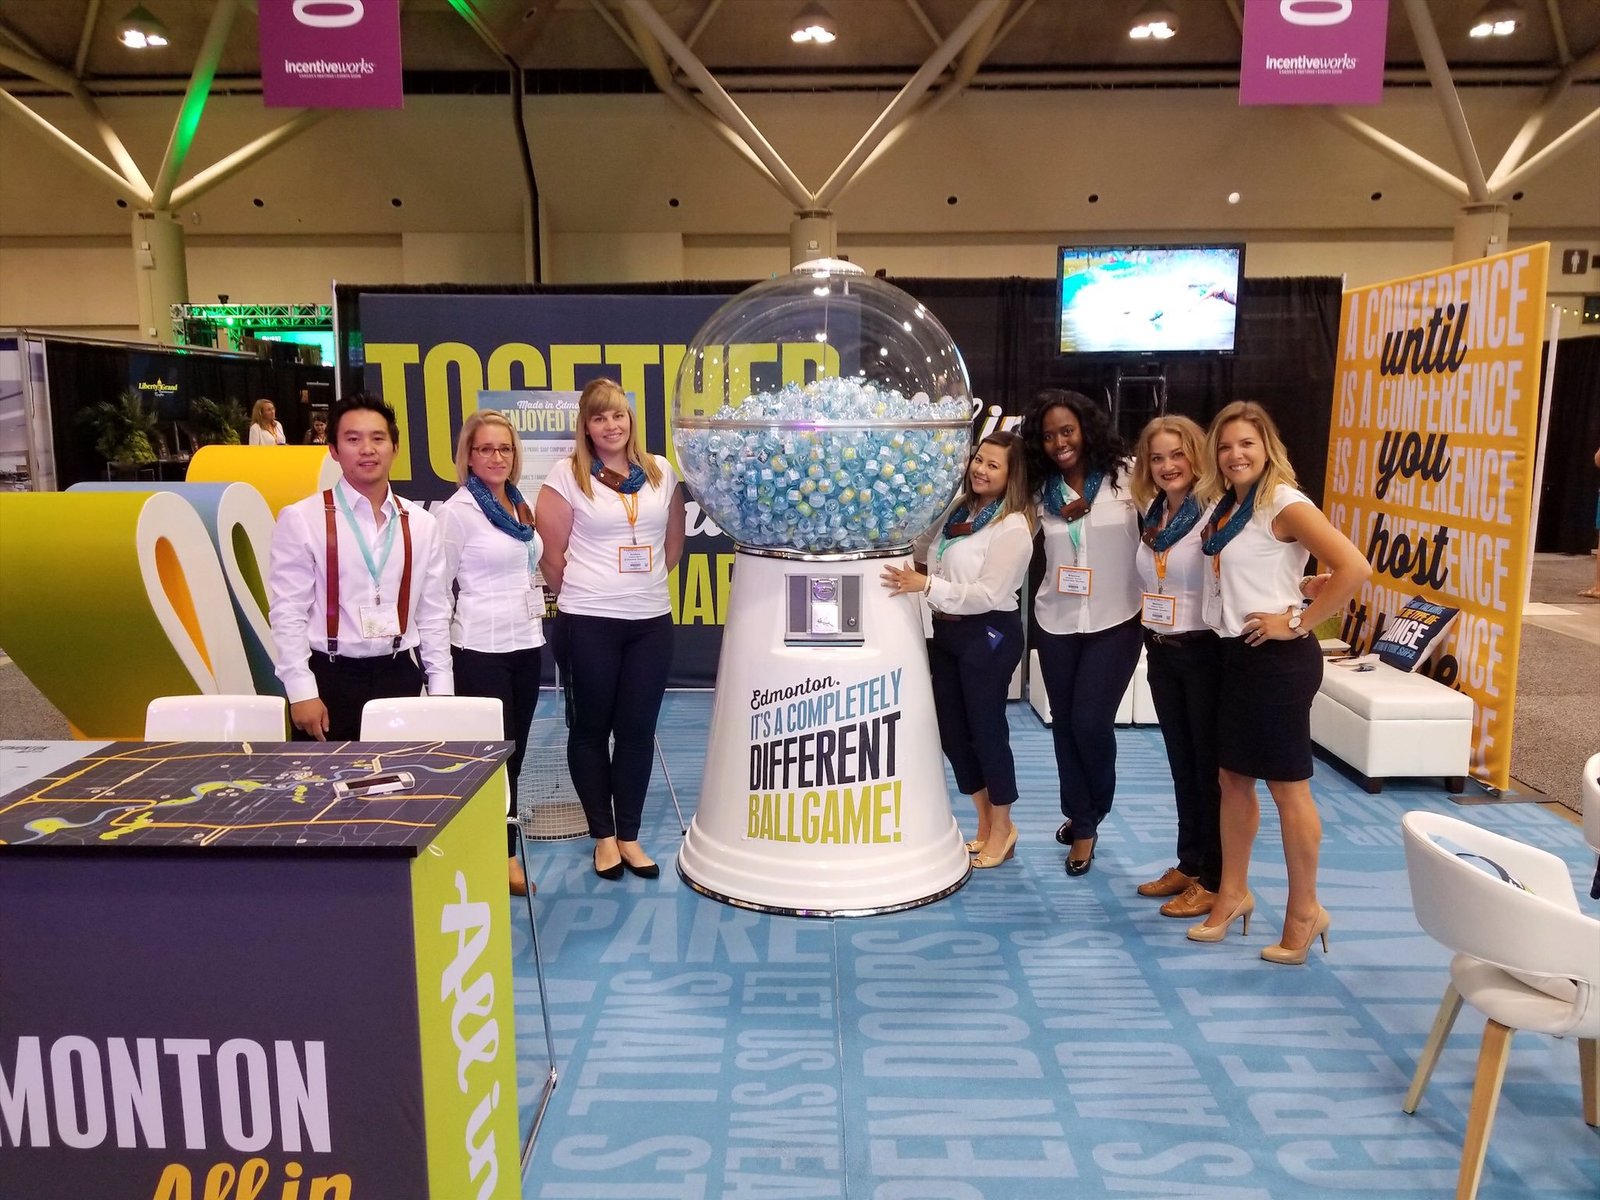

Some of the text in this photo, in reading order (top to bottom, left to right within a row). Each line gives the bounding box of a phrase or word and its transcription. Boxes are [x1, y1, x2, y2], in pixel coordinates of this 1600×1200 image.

[285, 58, 375, 75] incentiveworks
[1265, 53, 1357, 70] incentiveworks
[1344, 293, 1359, 361] A
[1380, 302, 1469, 376] until
[364, 342, 840, 484] TOTH
[517, 400, 543, 410] Made
[545, 400, 554, 410] in
[1339, 360, 1523, 437] IS A CONFERENCE
[1332, 437, 1351, 495] IS
[1353, 438, 1368, 497] A
[1375, 431, 1451, 500] you
[1366, 513, 1450, 591] host
[750, 667, 902, 741] IT'S A COMPLETELY
[751, 675, 840, 710] Edmonton.
[750, 711, 901, 791] DIFFERENT
[747, 780, 902, 845] BALLGAME!
[441, 870, 501, 1094] All
[741, 971, 833, 1016] LET
[851, 930, 1044, 1079] DOORS
[1010, 930, 1174, 1030] MINDS
[567, 971, 733, 1116] SMALL
[734, 1029, 839, 1073] US
[0, 1035, 332, 1153] MONTON
[1055, 1042, 1231, 1128] AND
